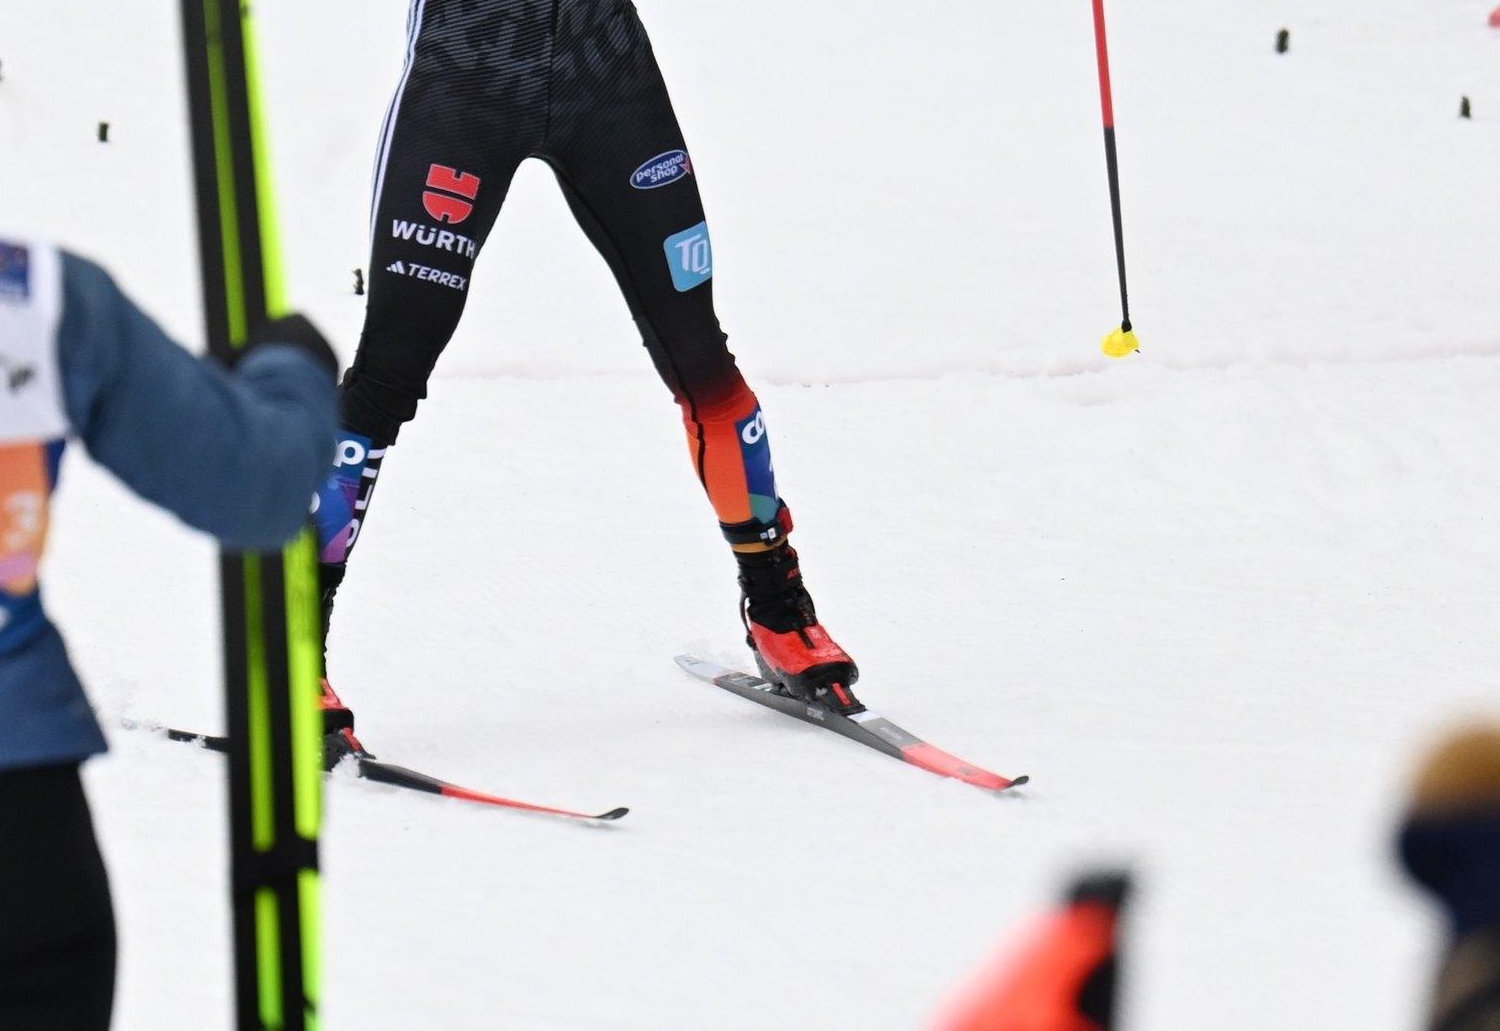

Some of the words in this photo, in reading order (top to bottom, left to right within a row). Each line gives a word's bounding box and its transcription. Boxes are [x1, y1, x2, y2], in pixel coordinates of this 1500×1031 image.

[636, 153, 684, 183] personal
[650, 165, 679, 183] shop
[392, 219, 476, 260] WÜRTH
[408, 262, 468, 291] TERREX
